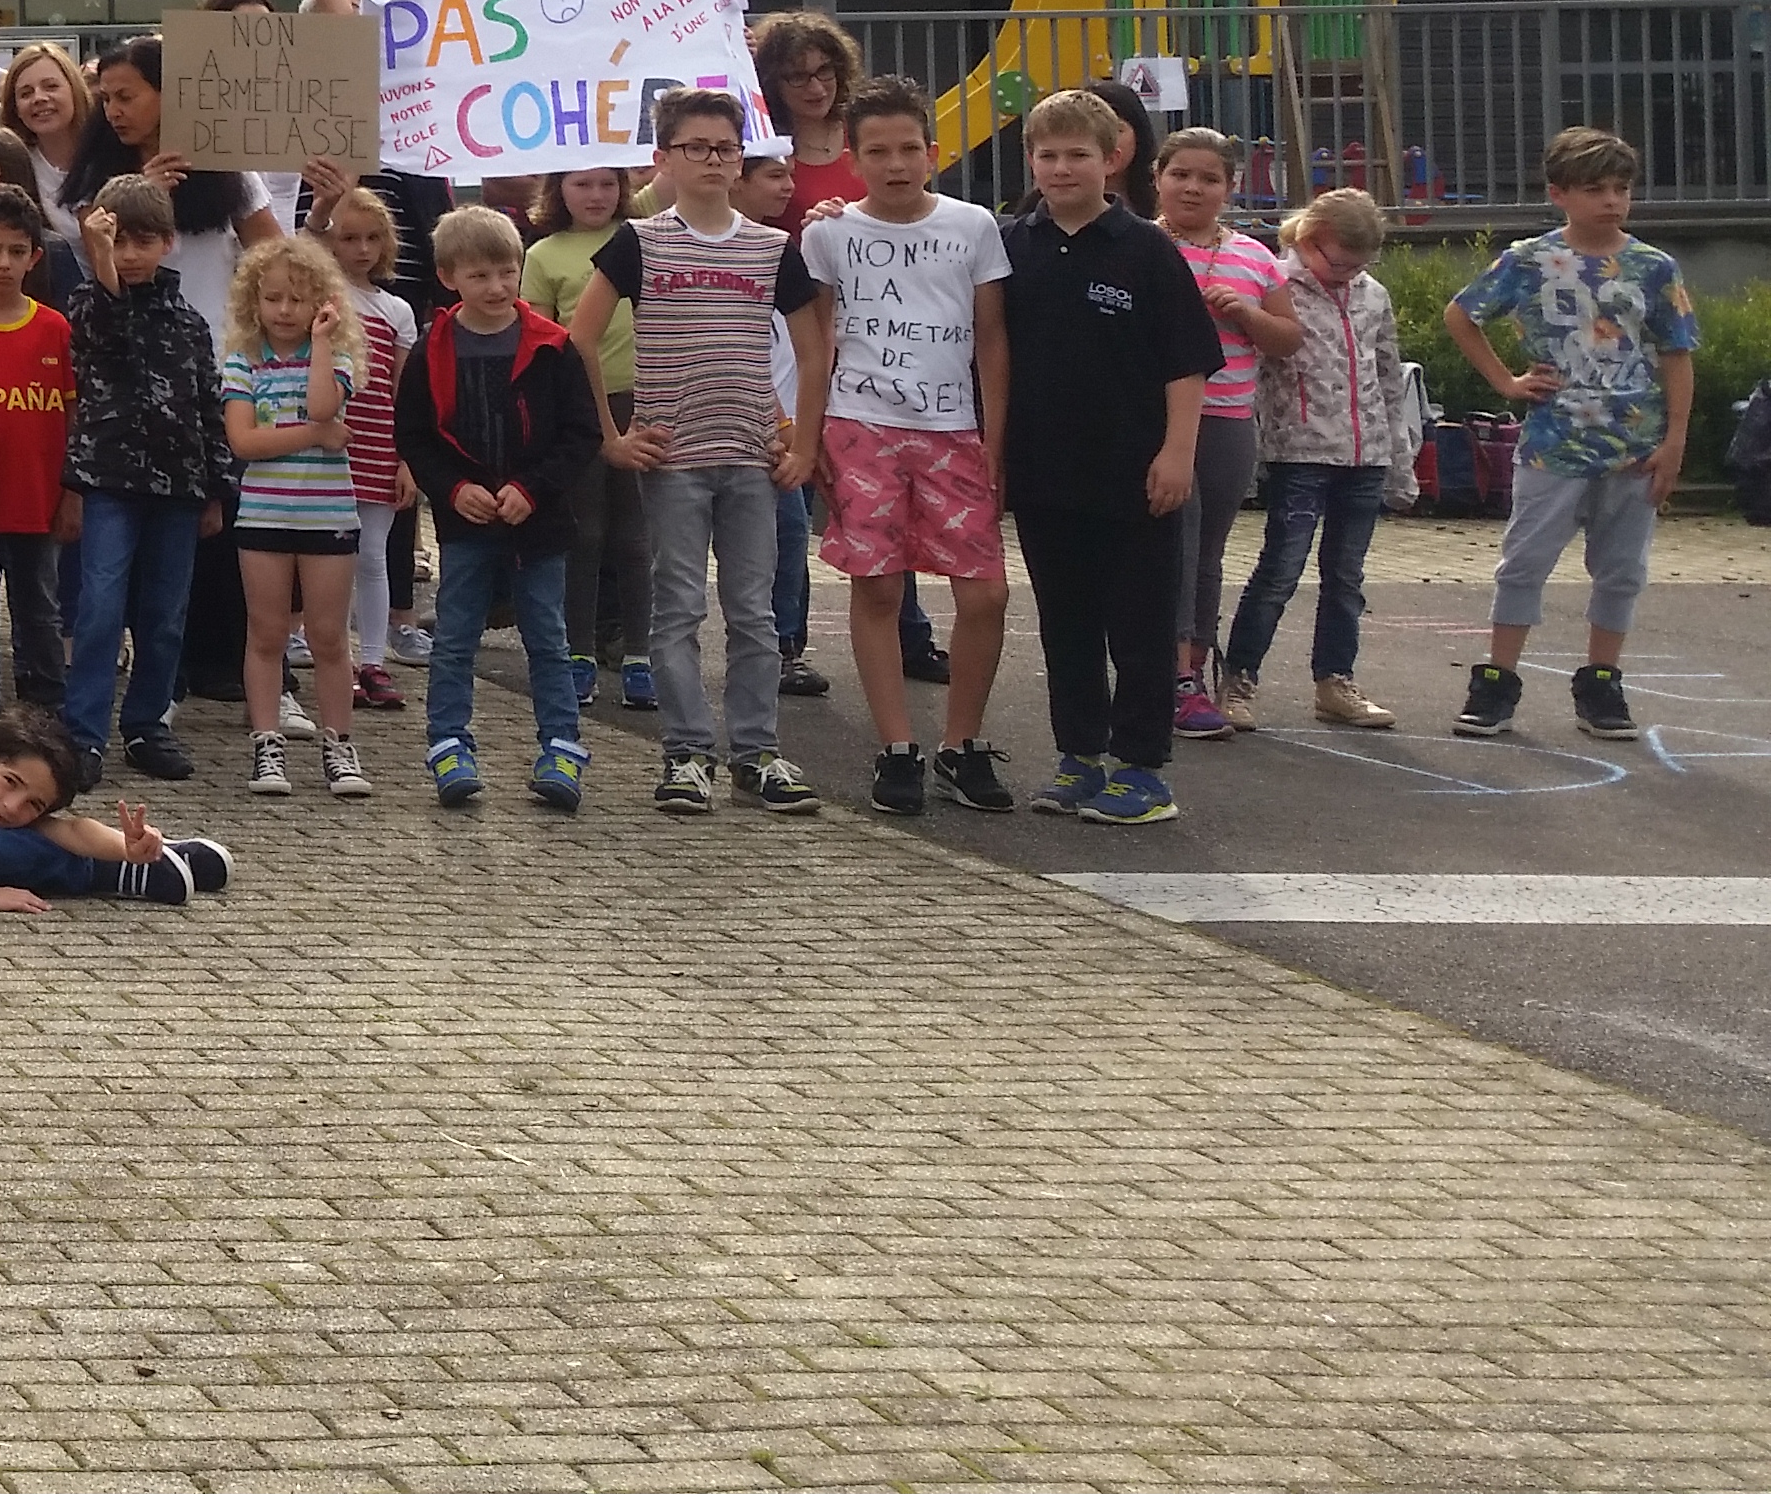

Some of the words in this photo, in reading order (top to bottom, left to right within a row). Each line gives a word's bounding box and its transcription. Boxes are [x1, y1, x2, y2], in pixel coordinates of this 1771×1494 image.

[232, 15, 295, 48] NON
[641, 15, 654, 32] A
[653, 2, 675, 21] LA
[200, 49, 222, 79] A
[254, 47, 295, 83] LA
[177, 76, 352, 119] FERMETURE
[390, 100, 433, 124] NOTRE
[192, 119, 235, 155] DE
[243, 118, 368, 161] CLASSE
[394, 122, 438, 152] ÉCOLE
[854, 276, 903, 305] LA
[882, 348, 914, 369] DE
